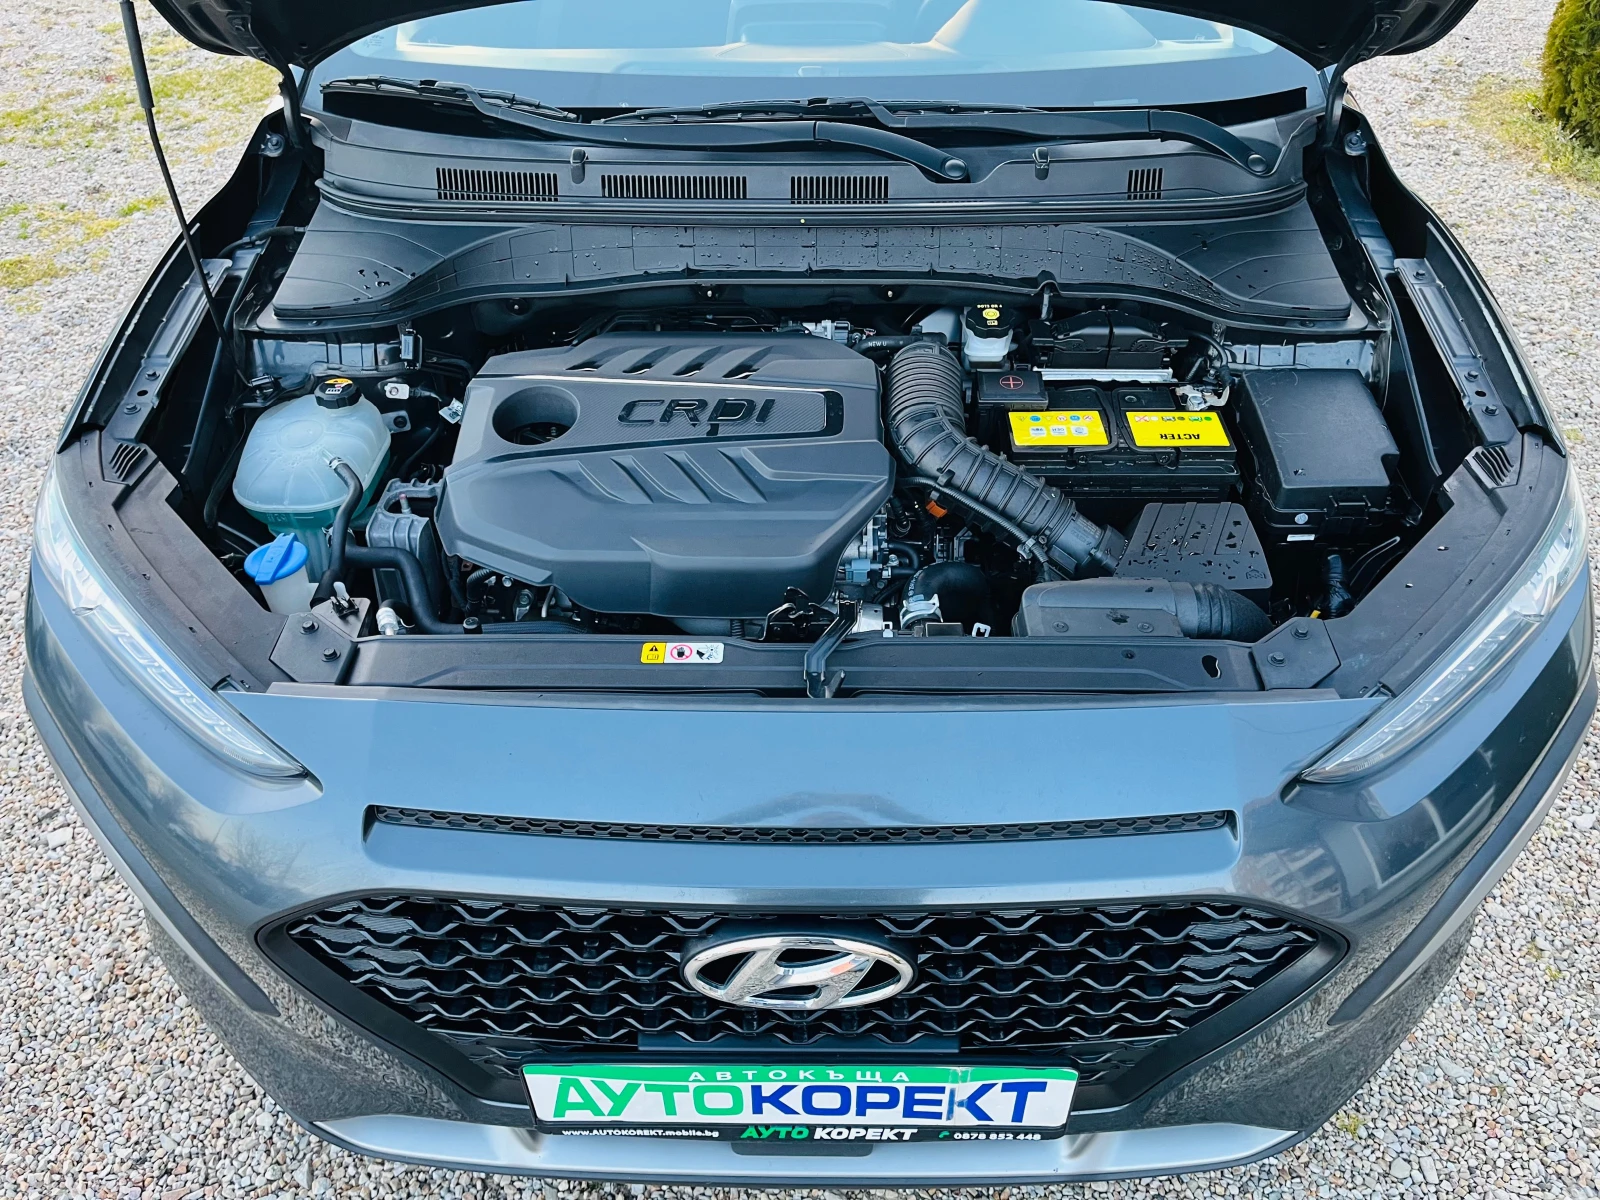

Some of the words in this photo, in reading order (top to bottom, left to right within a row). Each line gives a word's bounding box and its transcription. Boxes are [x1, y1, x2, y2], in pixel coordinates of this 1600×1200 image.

[617, 398, 776, 424] CRDI
[688, 1069, 910, 1083] АВТОКЪЩА
[561, 1128, 719, 1138] www.AUTOKOREKT.mobile.bg
[740, 1126, 809, 1139] АУТО
[814, 1127, 918, 1140] КОРЕКТ
[953, 1132, 987, 1141] 0878
[988, 1132, 1014, 1141] 852
[1015, 1132, 1042, 1141] 448
